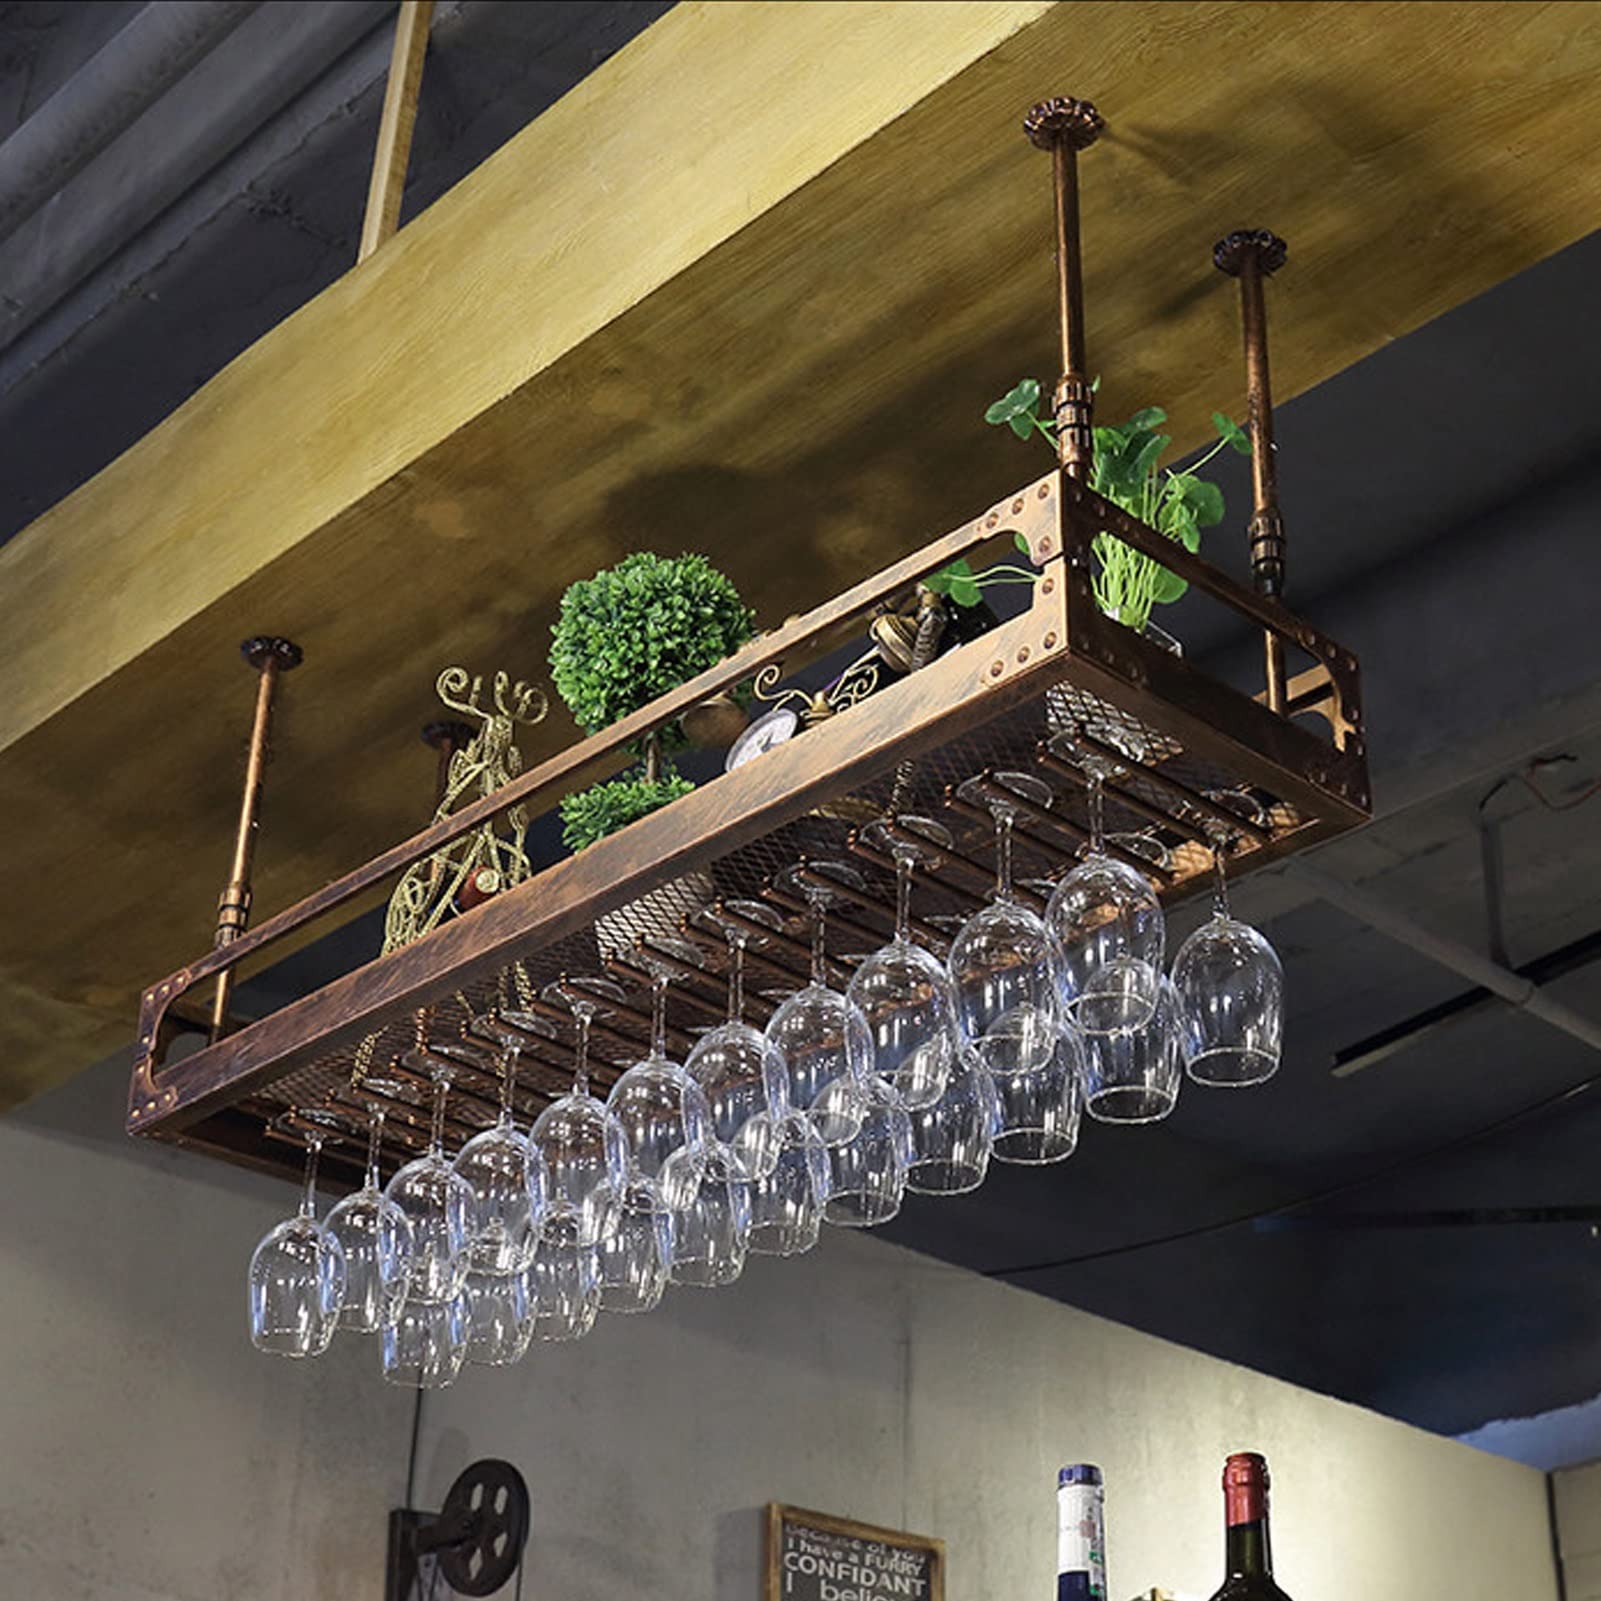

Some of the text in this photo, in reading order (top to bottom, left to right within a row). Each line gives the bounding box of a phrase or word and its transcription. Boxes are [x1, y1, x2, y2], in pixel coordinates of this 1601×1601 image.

[784, 1551, 926, 1596] CONFIDANT
[788, 1537, 922, 1577] I have a FURRY
[786, 1572, 793, 1593] I
